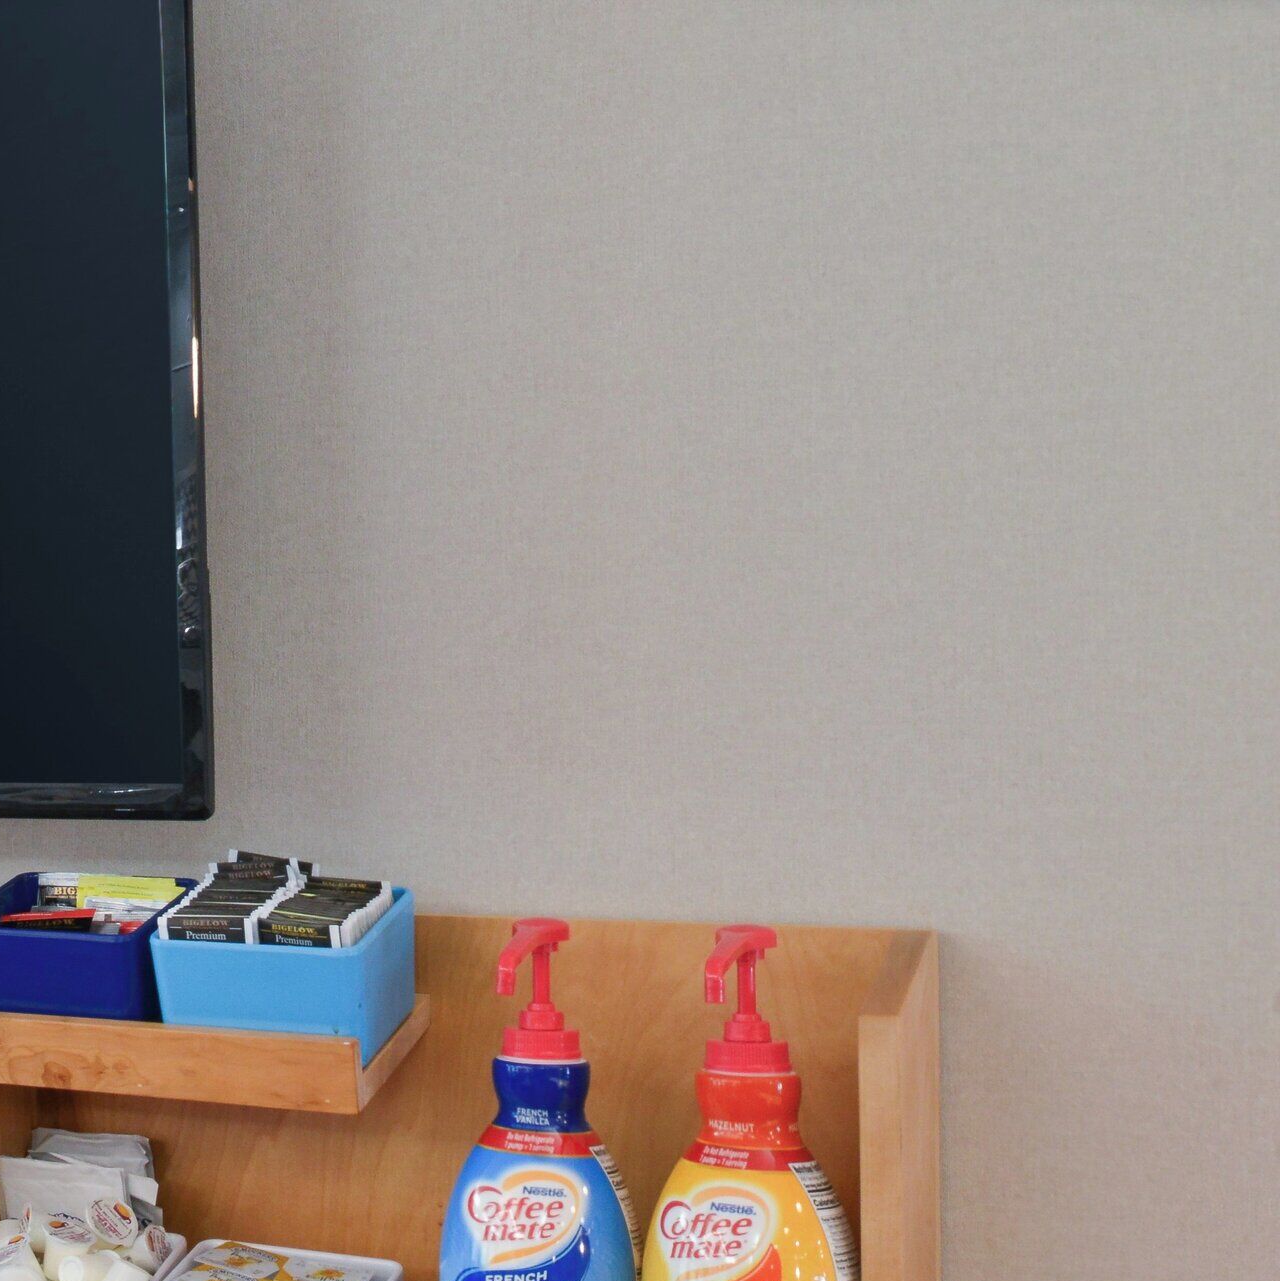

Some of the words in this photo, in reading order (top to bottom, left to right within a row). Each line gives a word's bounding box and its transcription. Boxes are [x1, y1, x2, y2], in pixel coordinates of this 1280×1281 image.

[182, 919, 228, 927] BIGELOW
[271, 923, 316, 934] BIGELOW
[185, 930, 227, 941] Premium
[275, 934, 313, 947] Premium
[517, 1107, 548, 1117] FRENCH
[515, 1115, 550, 1126] VANILLA
[708, 1119, 755, 1133] HAZELNUT
[468, 1185, 564, 1224] Coffee
[660, 1200, 753, 1240] Coffee
[482, 1221, 556, 1241] mate
[670, 1239, 742, 1259] mate
